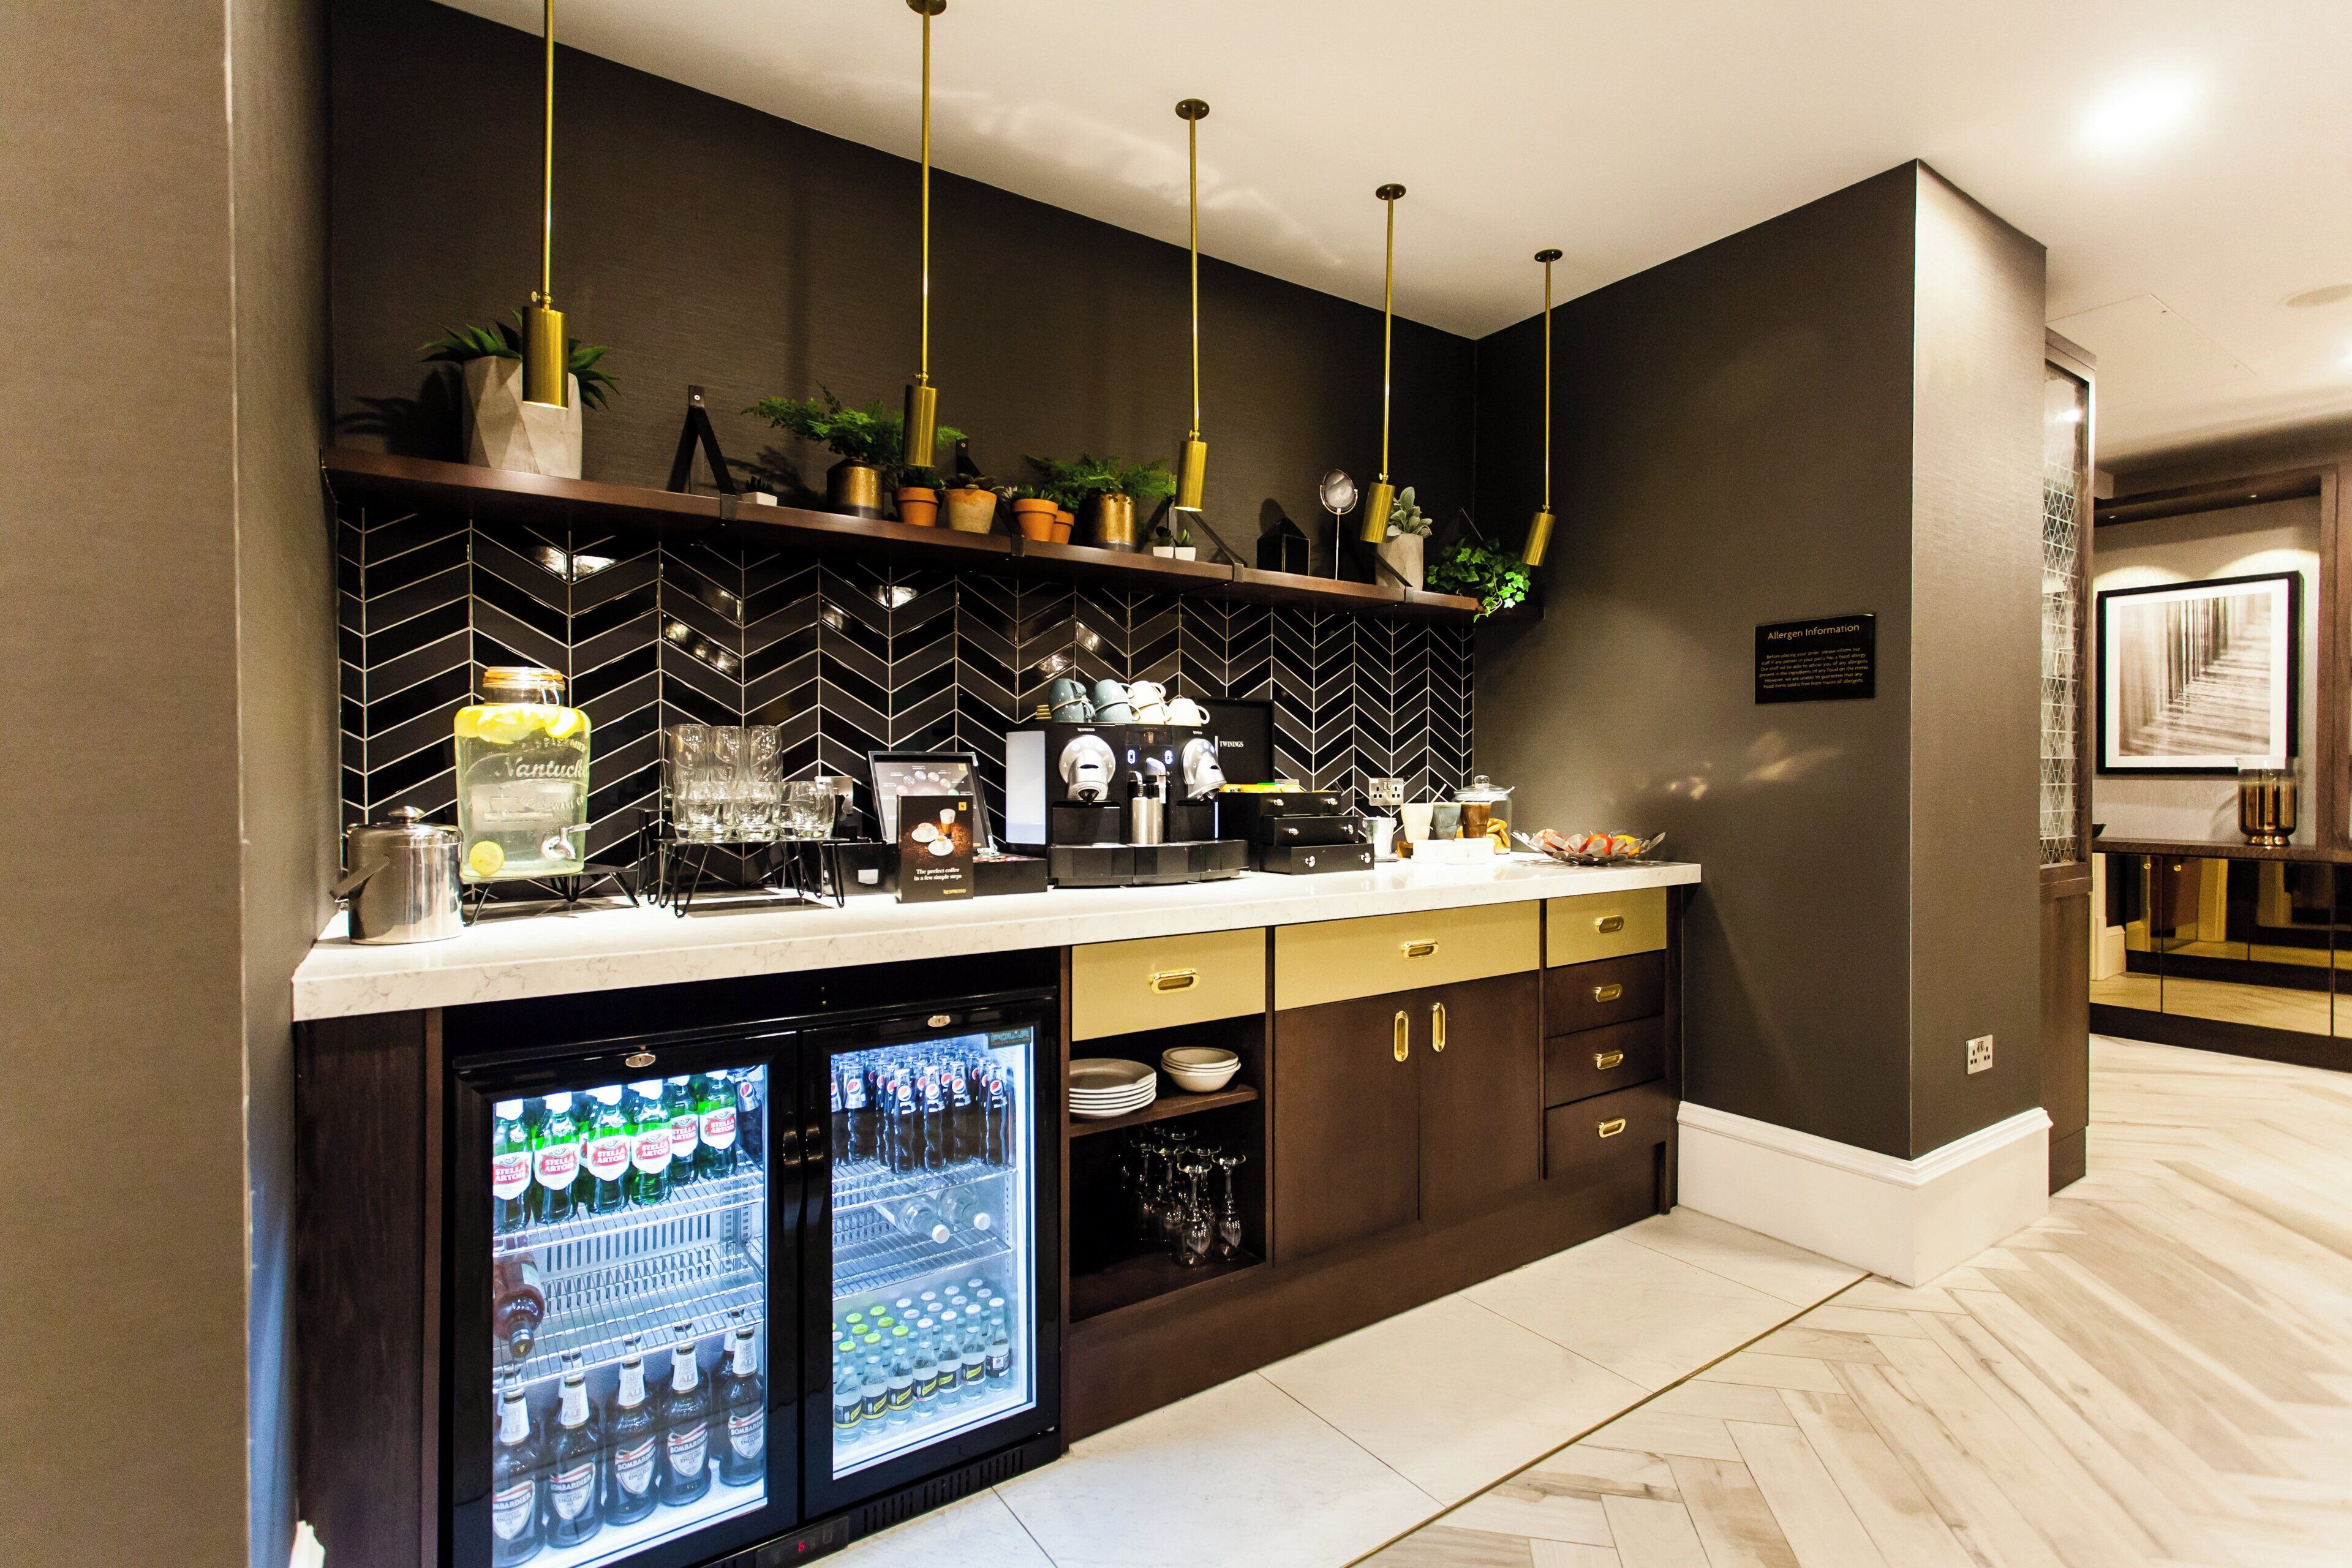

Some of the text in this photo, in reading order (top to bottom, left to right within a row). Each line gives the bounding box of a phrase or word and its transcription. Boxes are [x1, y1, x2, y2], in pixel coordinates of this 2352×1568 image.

[1767, 624, 1860, 641] Allergen Information
[990, 1030, 1030, 1042] POLAR
[679, 1373, 695, 1383] ALE
[626, 1387, 643, 1398] ALE
